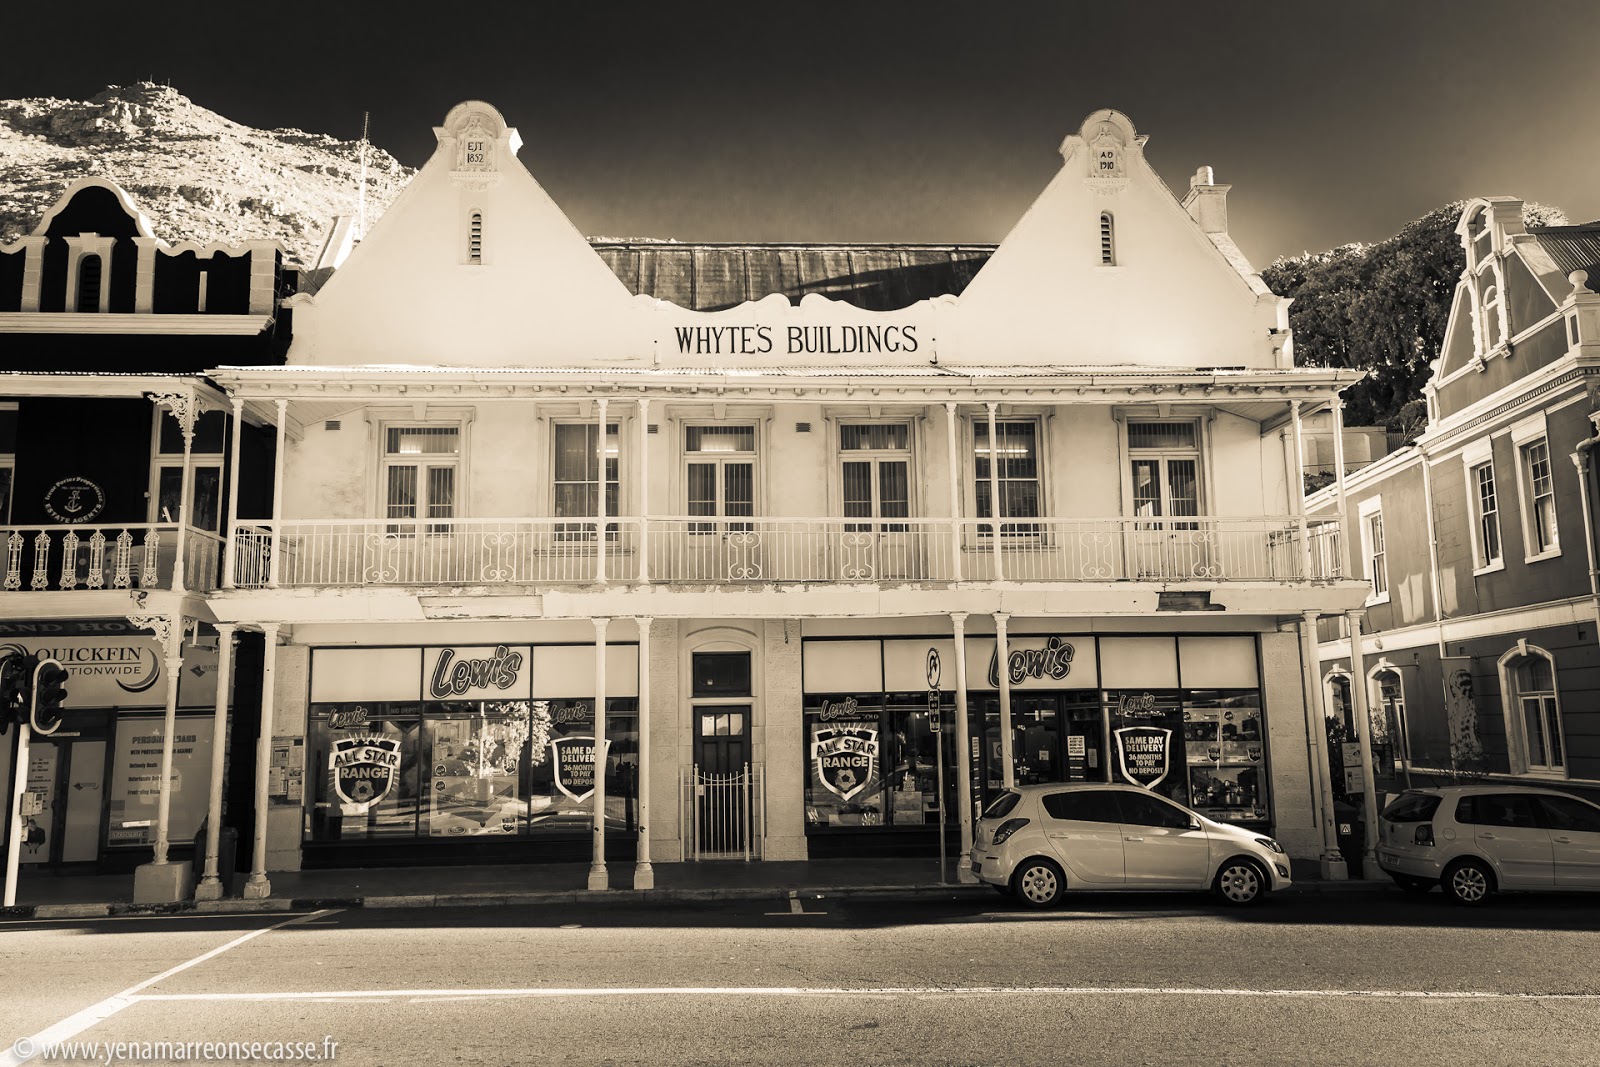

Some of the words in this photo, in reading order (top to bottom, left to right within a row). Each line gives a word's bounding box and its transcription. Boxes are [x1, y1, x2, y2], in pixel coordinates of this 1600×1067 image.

[467, 153, 484, 163] 1852
[1100, 161, 1114, 169] 1910
[674, 323, 773, 354] WHYTE'S
[786, 325, 919, 354] BUILDINGS
[45, 503, 71, 523] ESTATE
[72, 504, 102, 523] AGENTS
[36, 647, 143, 662] QUICKFIN
[430, 645, 523, 699] Lewis
[820, 696, 858, 721] Lewis
[1118, 692, 1156, 715] Lewis
[327, 706, 368, 730] Lewis
[550, 702, 588, 726] Lewis
[561, 747, 584, 755] SAME
[817, 740, 842, 757] ALL
[844, 738, 876, 756] STAR
[335, 751, 361, 768] ALL
[364, 749, 397, 766] STAR
[562, 755, 595, 763] DELIVER
[823, 757, 868, 768] RANGE
[341, 768, 388, 779] RANGE
